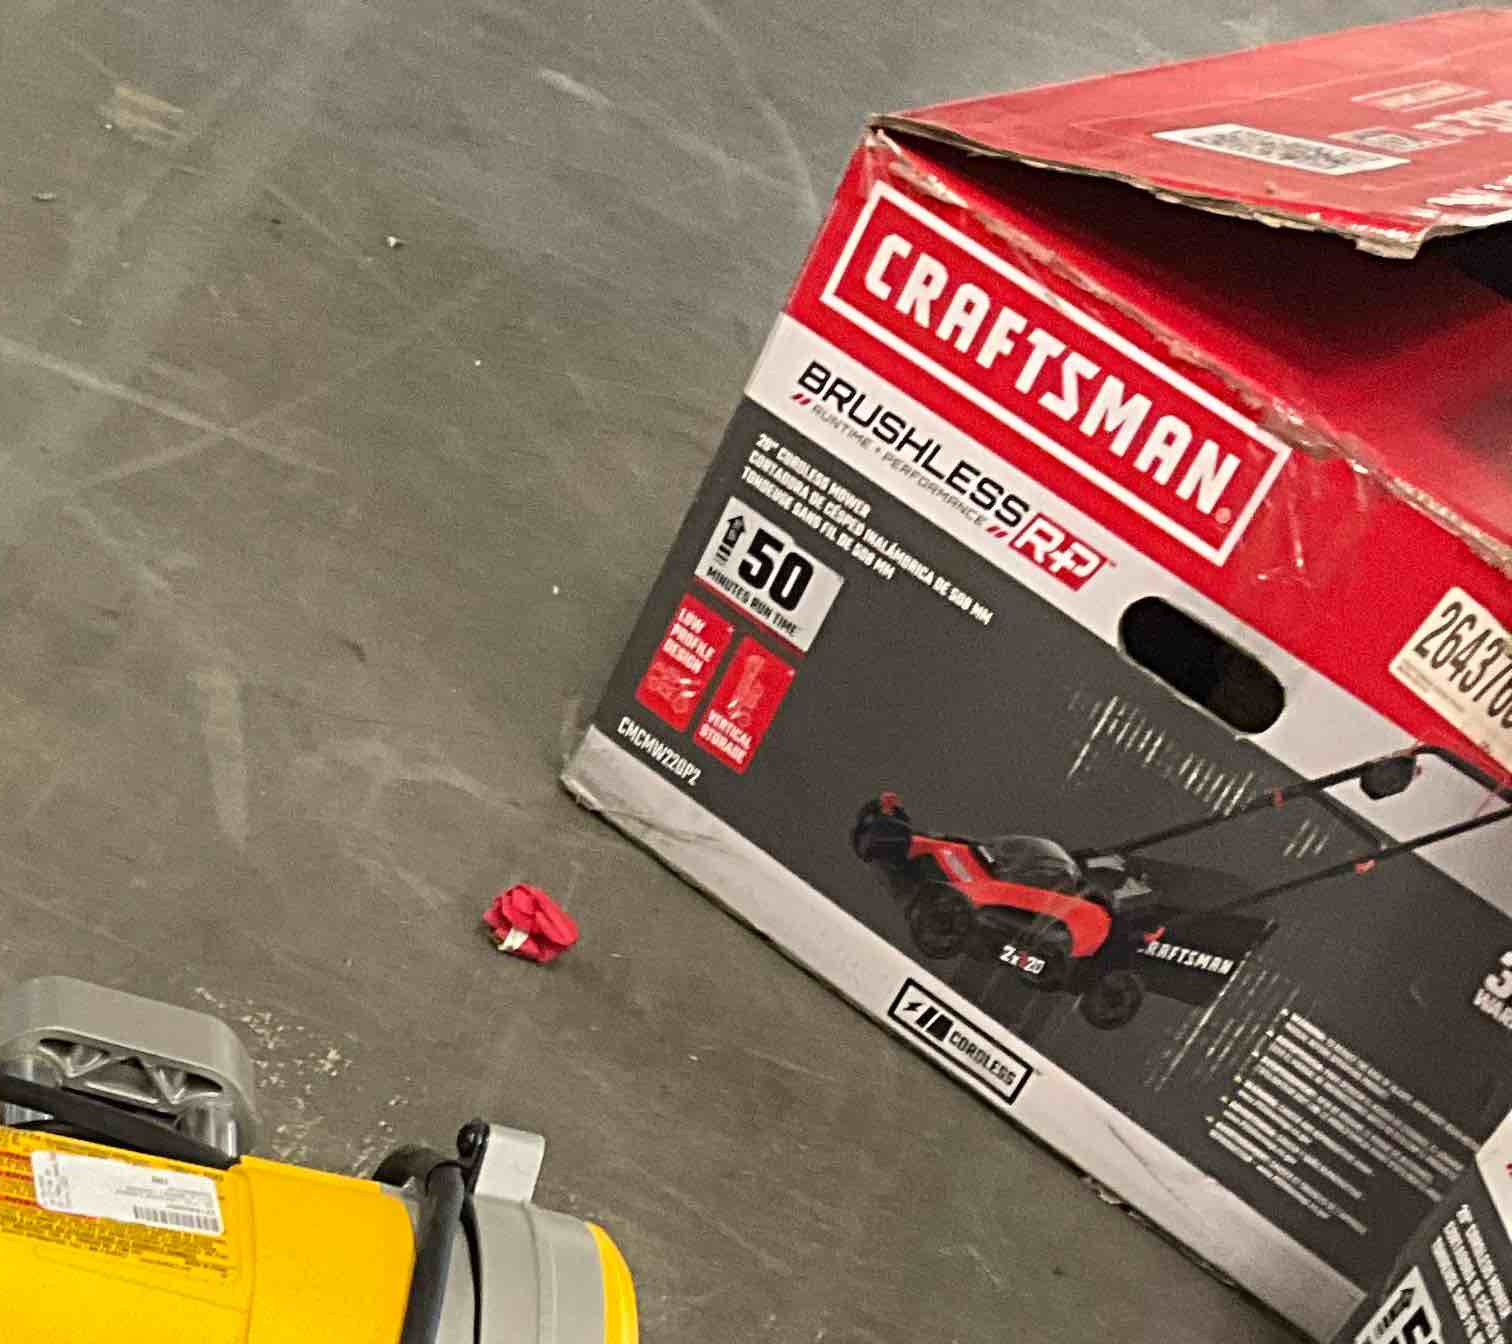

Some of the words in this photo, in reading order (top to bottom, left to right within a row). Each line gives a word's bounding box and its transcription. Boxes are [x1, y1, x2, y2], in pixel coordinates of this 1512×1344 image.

[864, 233, 1241, 515] CRAFTSMAN
[797, 361, 1029, 529] BRUSHLESS
[812, 403, 870, 449] RUNTIME
[880, 452, 986, 527] PERFORMANCE
[738, 528, 815, 612] 50
[772, 608, 799, 635] TIME
[1136, 940, 1234, 975] RAFTSMAN
[949, 1030, 1017, 1086] CORDLESS
